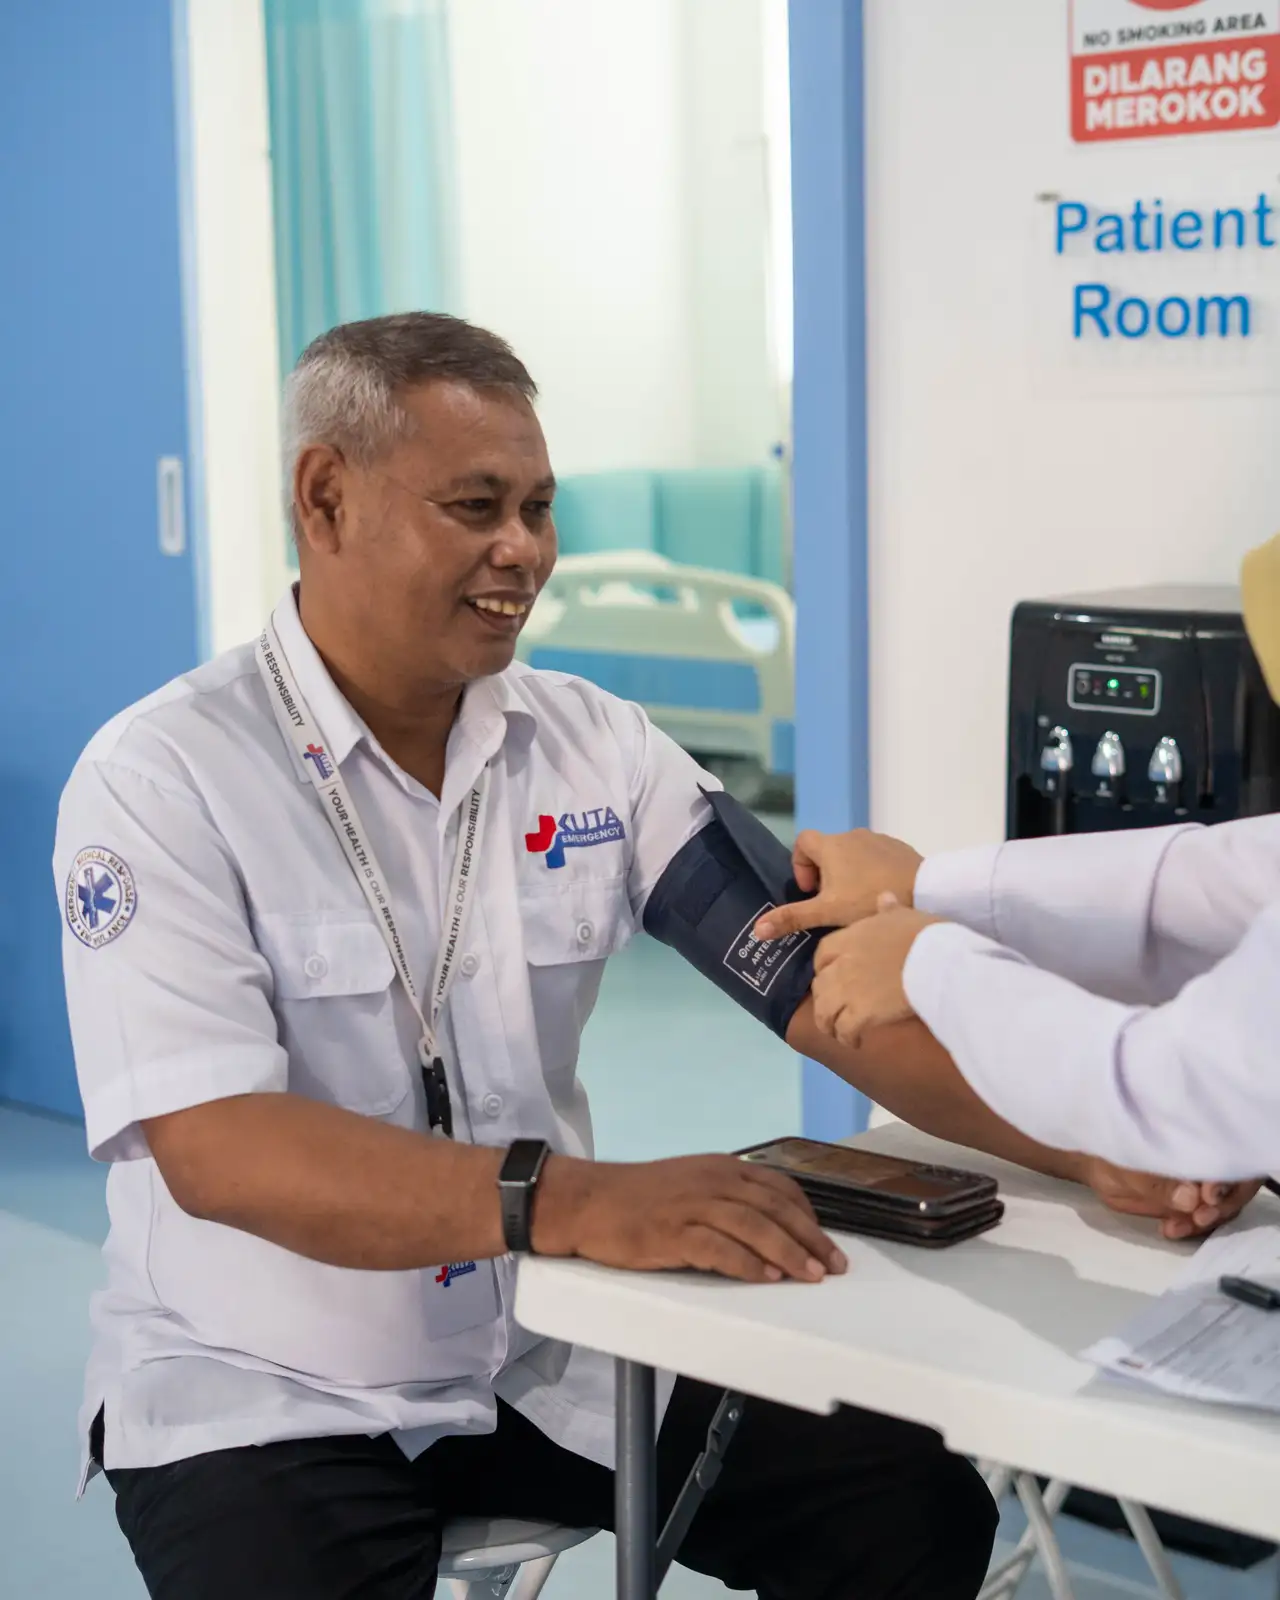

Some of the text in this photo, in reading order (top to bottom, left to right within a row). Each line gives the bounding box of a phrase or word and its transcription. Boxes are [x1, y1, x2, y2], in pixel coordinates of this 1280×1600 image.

[1084, 12, 1267, 48] NO SMOKING AREA
[1083, 47, 1267, 97] DILARANG
[1085, 84, 1265, 131] MEROKOK
[1054, 193, 1275, 256] Patient
[1072, 283, 1251, 340] Room
[264, 651, 305, 727] RESPONSIBILITY
[557, 806, 620, 832] KUTA
[561, 826, 621, 843] EMERGENCY
[328, 787, 417, 997] YOUR HEALTH IS OUR RESPONSIBIL
[436, 788, 482, 997] YOUR HEALTH IS OUR RESPONSIBILITY
